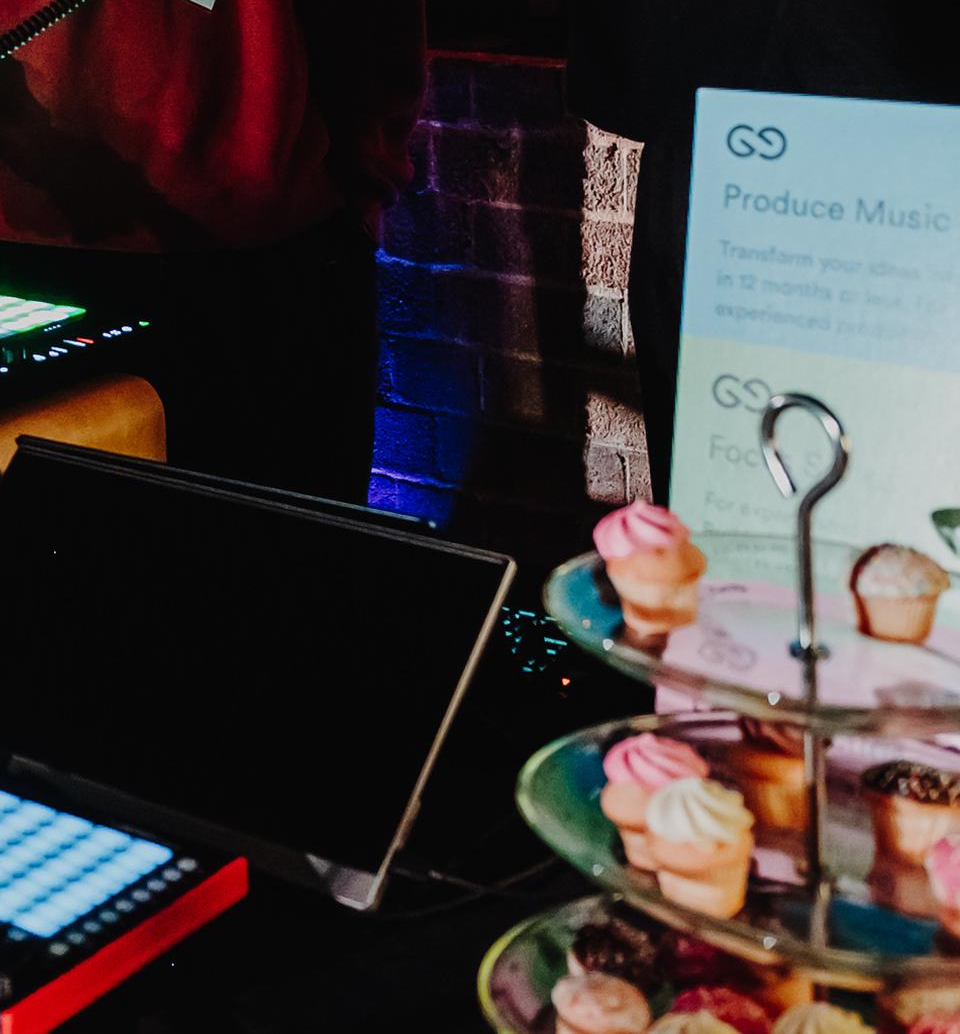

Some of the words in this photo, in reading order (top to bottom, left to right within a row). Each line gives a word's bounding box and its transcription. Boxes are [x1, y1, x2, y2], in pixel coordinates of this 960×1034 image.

[723, 182, 845, 221] Produce
[855, 197, 951, 232] Music
[719, 239, 814, 267] Transform
[762, 278, 832, 301] months
